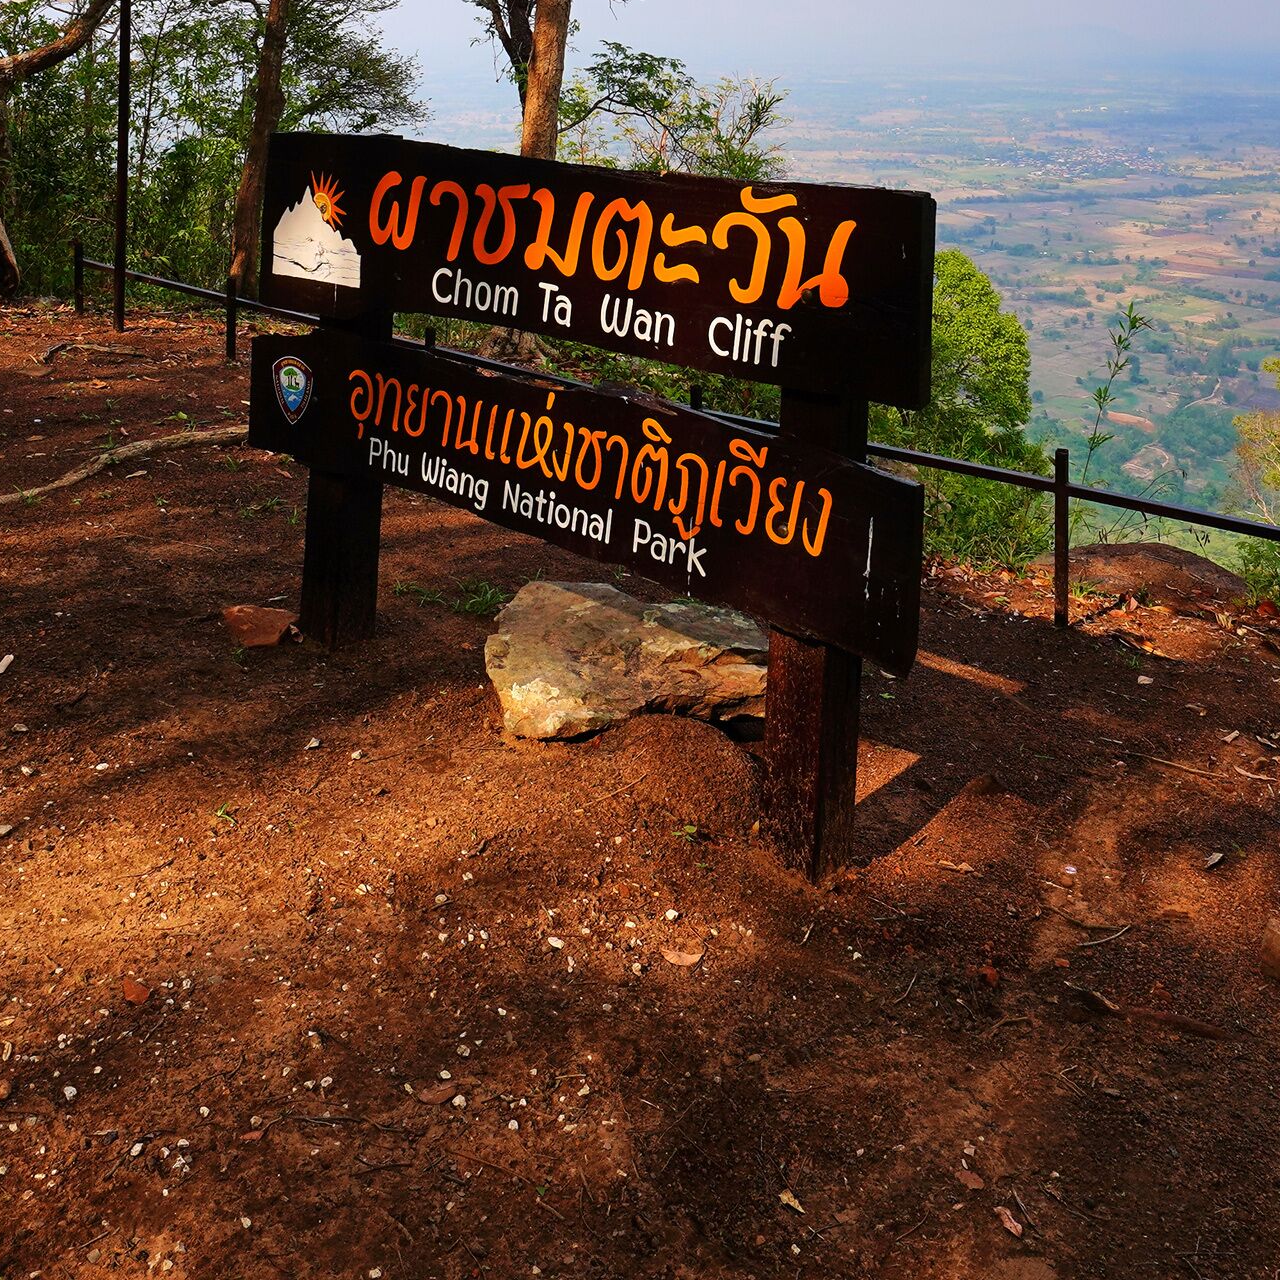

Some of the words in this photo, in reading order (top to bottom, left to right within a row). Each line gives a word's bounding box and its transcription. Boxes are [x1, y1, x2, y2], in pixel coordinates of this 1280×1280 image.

[369, 170, 857, 309] ผาชมตะวัน
[432, 267, 519, 316] Chom
[538, 281, 571, 328] Ta
[600, 294, 675, 347] Wan
[708, 313, 792, 367] Cliff
[348, 369, 832, 557] อุทยานแห่งชาติภูเวียง
[369, 437, 410, 476] Phu
[421, 452, 489, 511] Wiang
[502, 480, 613, 545] National
[632, 518, 707, 578] Park
